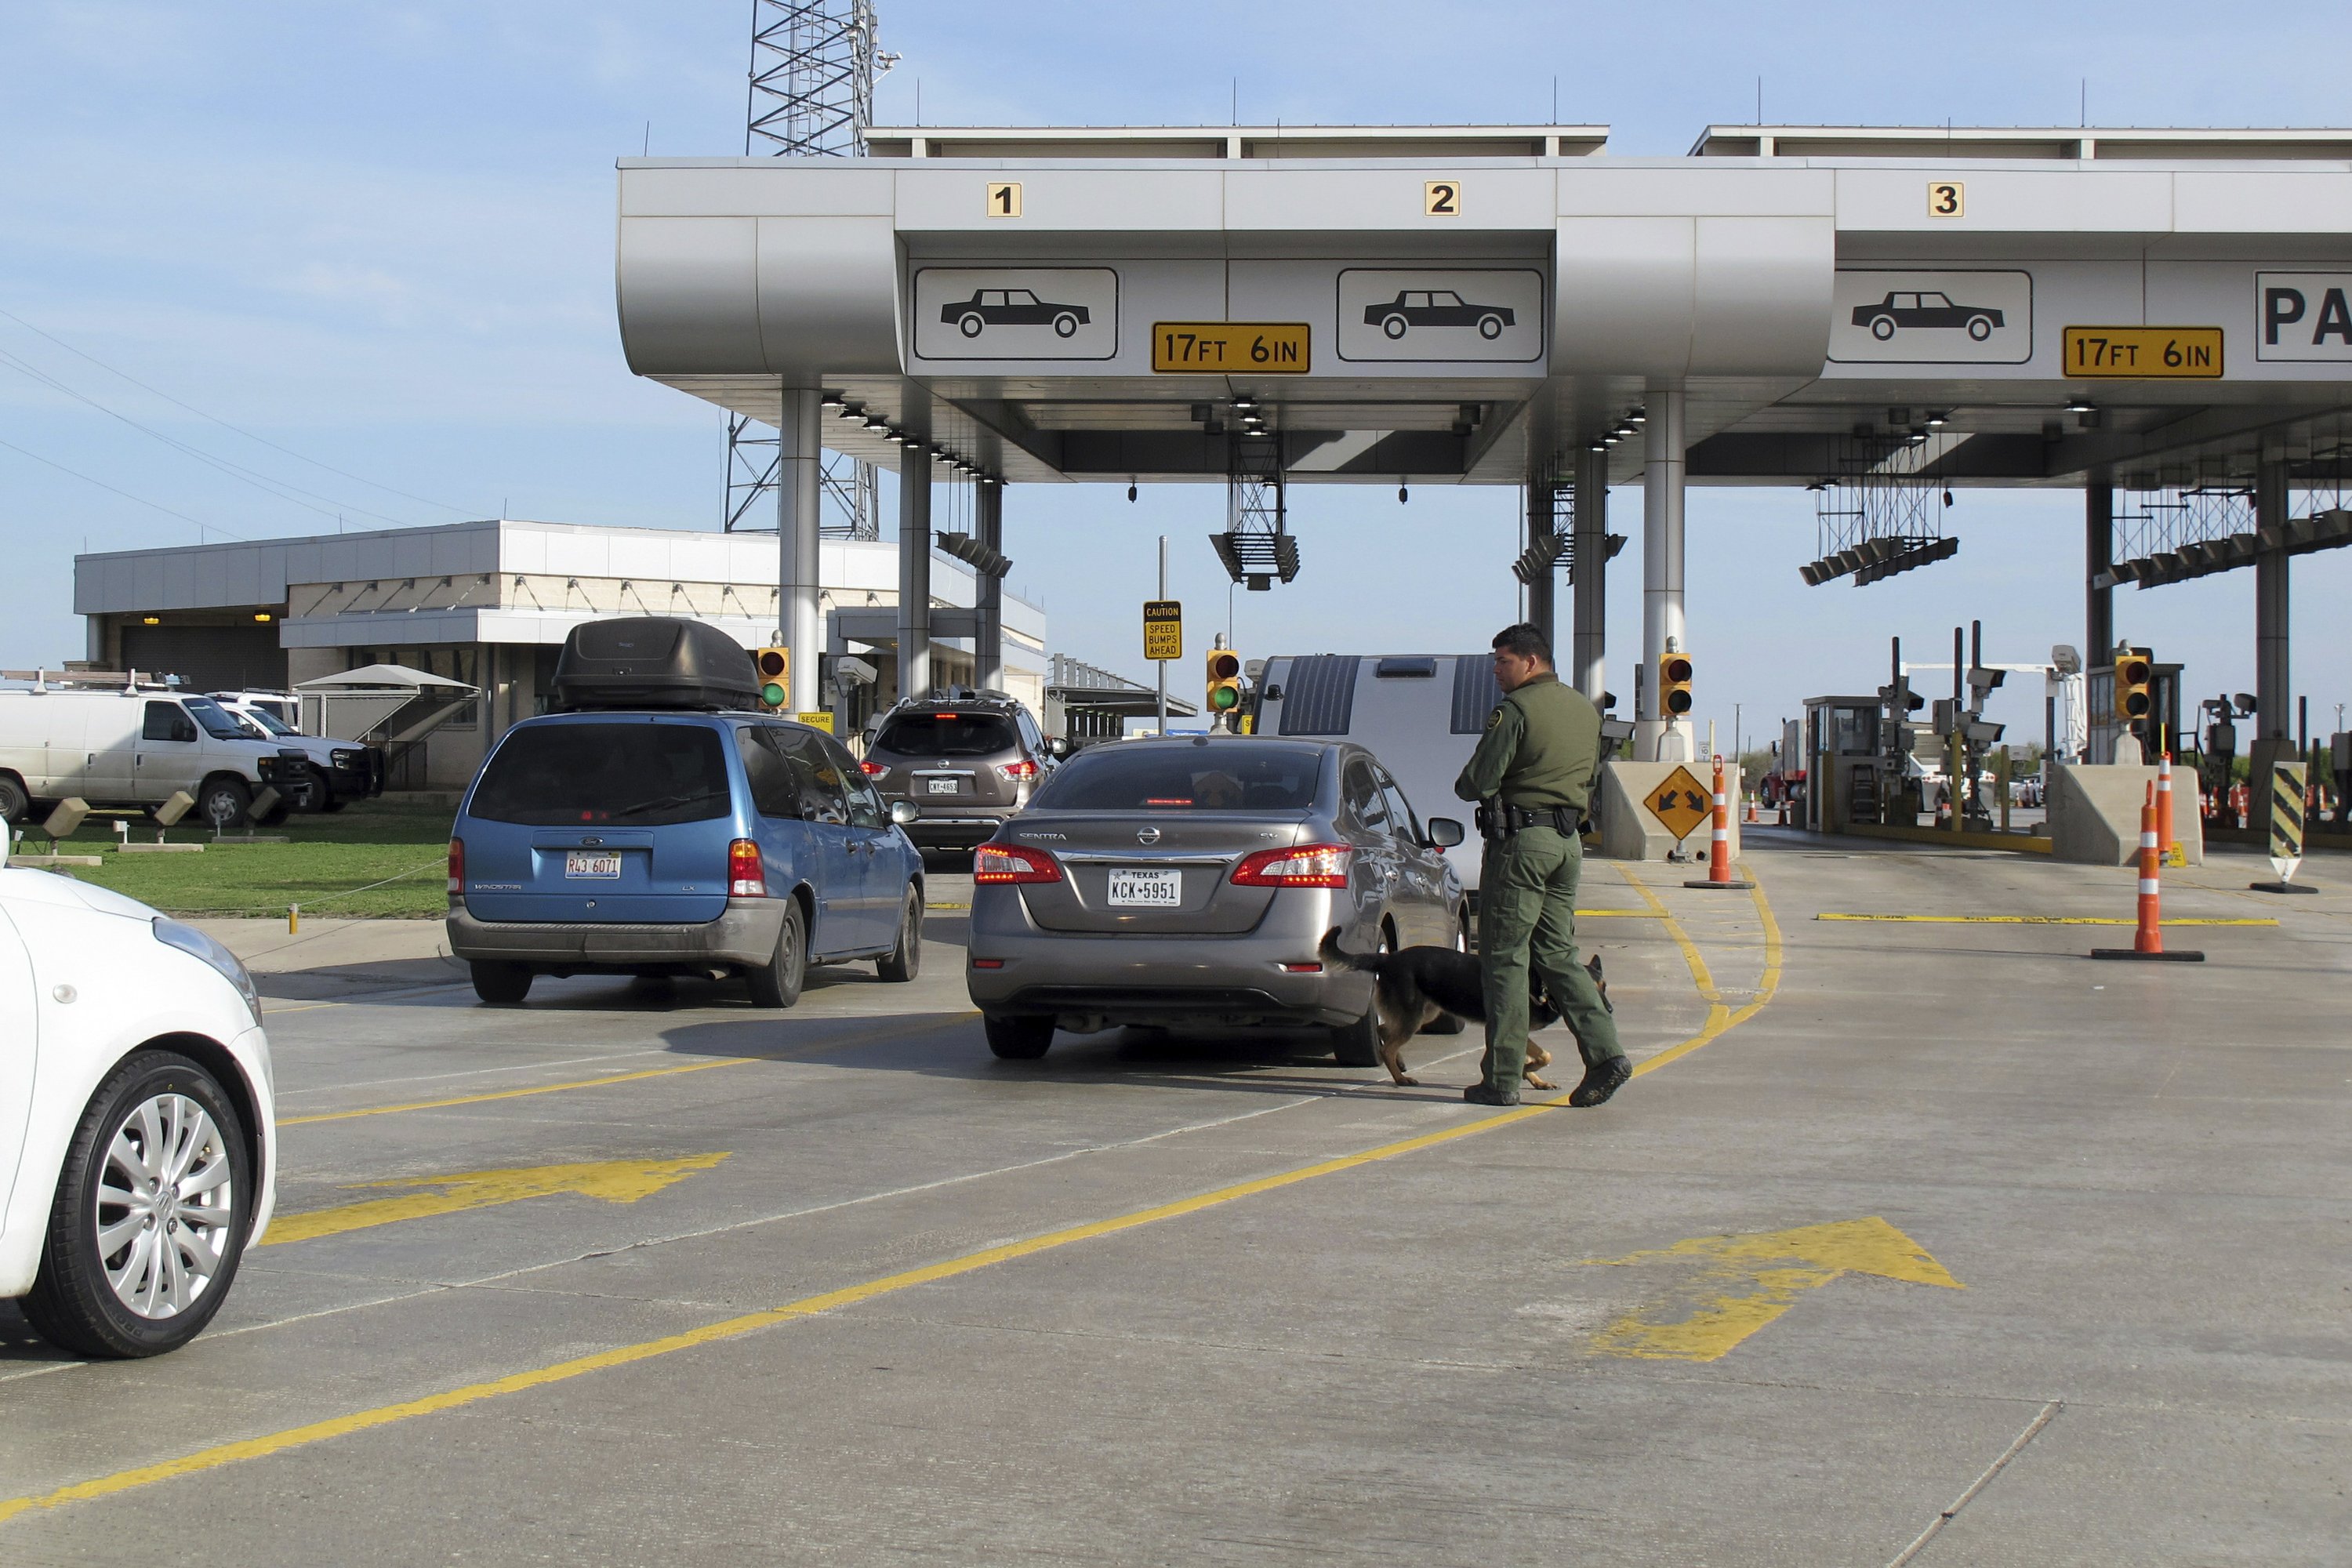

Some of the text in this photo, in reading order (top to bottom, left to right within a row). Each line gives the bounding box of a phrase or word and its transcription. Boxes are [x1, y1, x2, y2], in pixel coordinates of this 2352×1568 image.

[995, 186, 1011, 214] 1
[1431, 185, 1454, 212] 2
[1935, 186, 1958, 214] 3
[1165, 333, 1297, 363] 17FT 6IN
[2076, 338, 2210, 368] 17FT 6IN
[1146, 608, 1179, 617] CAUTION
[1149, 624, 1176, 633] SPEED
[1149, 635, 1178, 644] BUMPS
[1149, 645, 1176, 655] AHEAD
[568, 858, 618, 873] R43 6071
